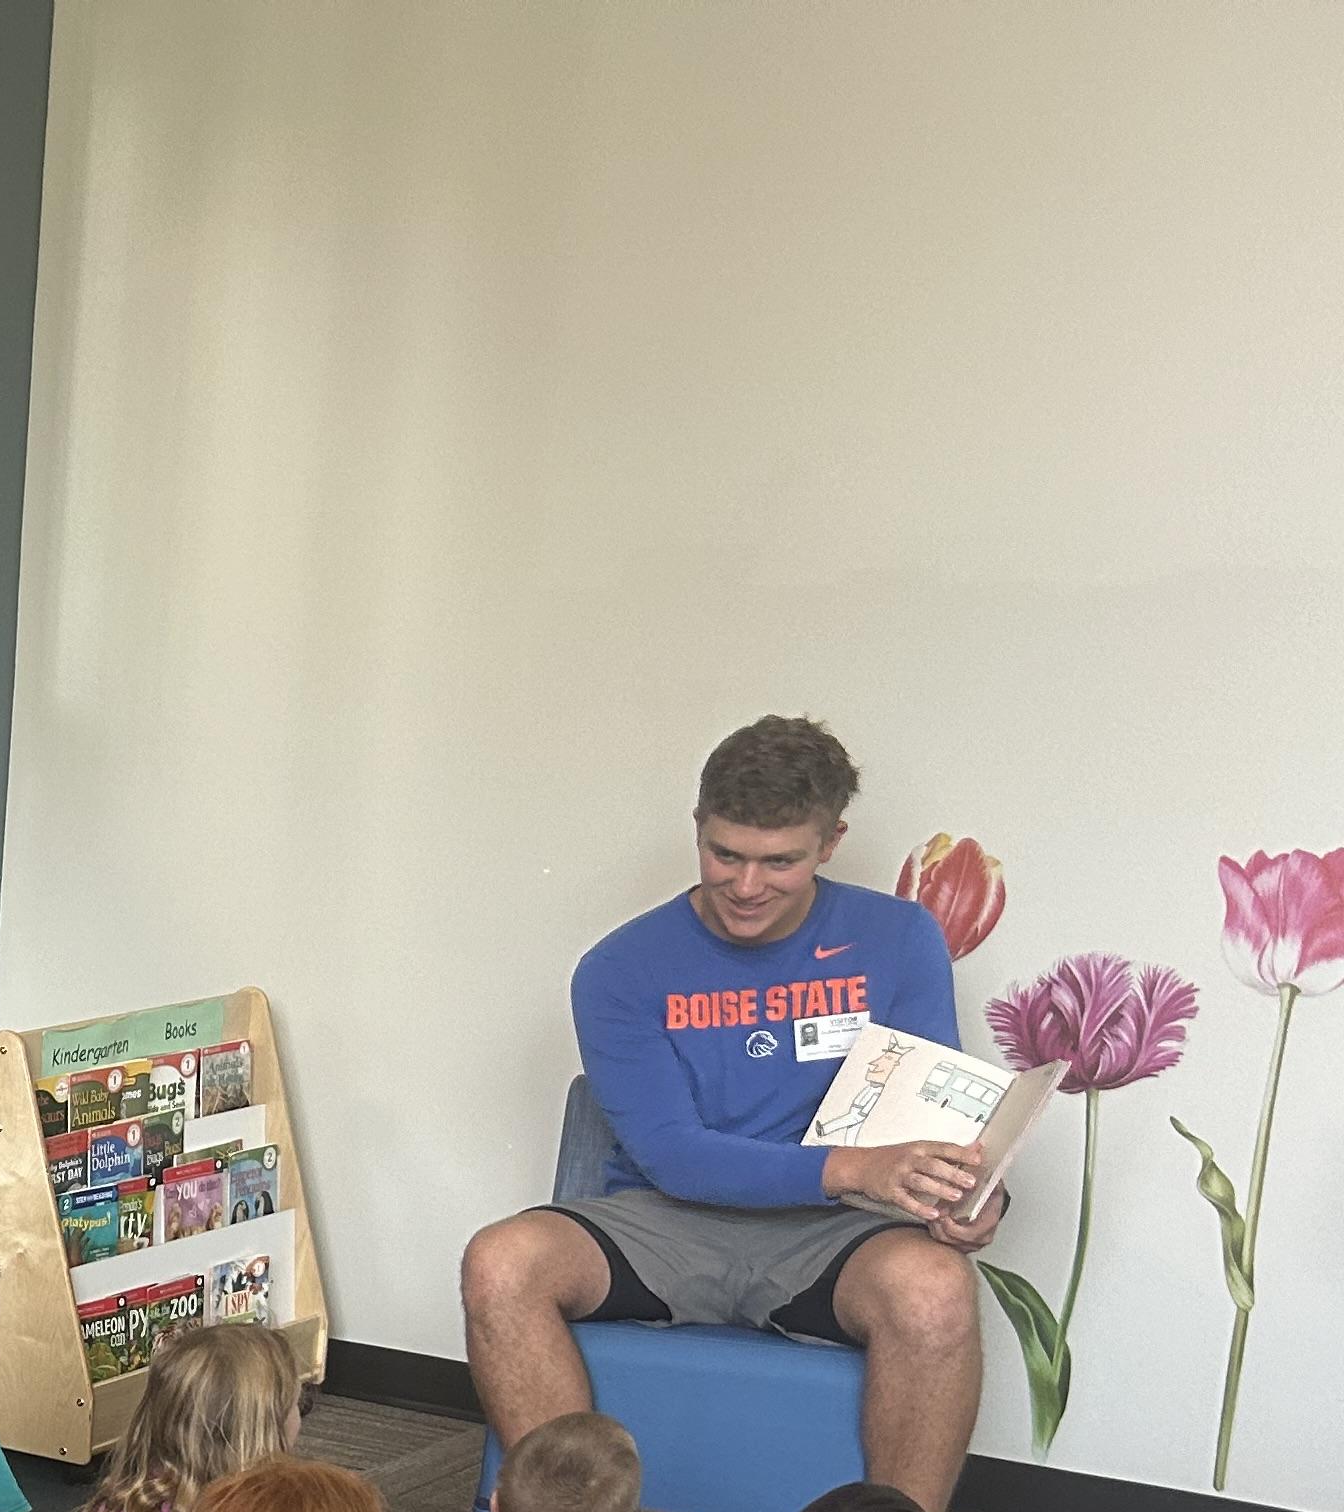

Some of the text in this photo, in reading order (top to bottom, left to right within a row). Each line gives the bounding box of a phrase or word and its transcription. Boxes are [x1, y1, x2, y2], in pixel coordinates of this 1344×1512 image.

[666, 976, 869, 1030] BOISE STATE
[52, 1020, 197, 1067] Kindergarten Books
[112, 1074, 119, 1086] 1
[71, 1091, 89, 1106] Wild
[90, 1086, 109, 1104] Baby
[72, 1104, 116, 1127] Animals
[132, 1129, 137, 1141] 1
[91, 1142, 115, 1158] Little
[266, 1152, 273, 1165] 2
[92, 1150, 131, 1172] Dolphin
[67, 1167, 83, 1180] DAY
[177, 1181, 198, 1200] YOU
[63, 1199, 70, 1211] 2
[170, 1294, 198, 1320] ZOO
